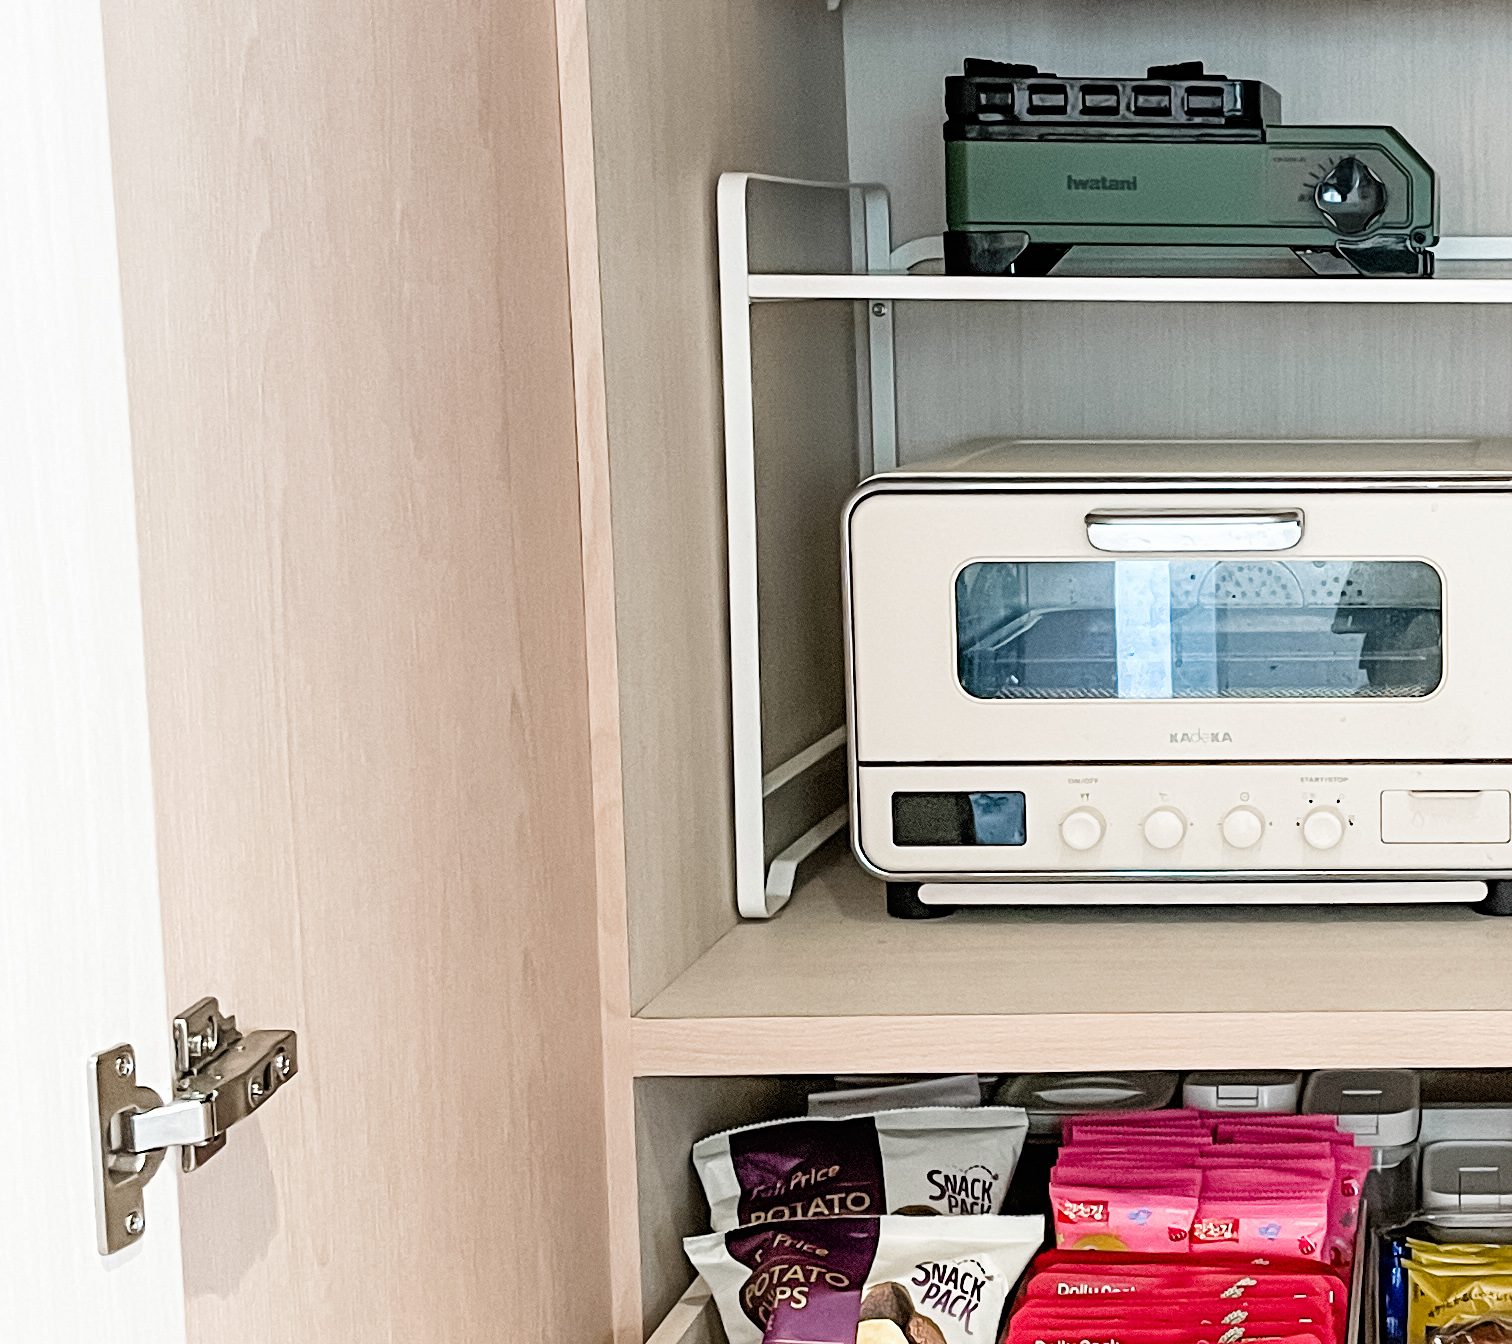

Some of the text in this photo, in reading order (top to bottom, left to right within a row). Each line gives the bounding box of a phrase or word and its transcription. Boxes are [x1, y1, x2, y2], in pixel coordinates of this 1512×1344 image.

[750, 1191, 871, 1224] POTATO
[926, 1169, 993, 1205] SNACK
[745, 1264, 850, 1309] POTATO
[911, 1260, 987, 1303] SNACK
[920, 1282, 979, 1336] PACK
